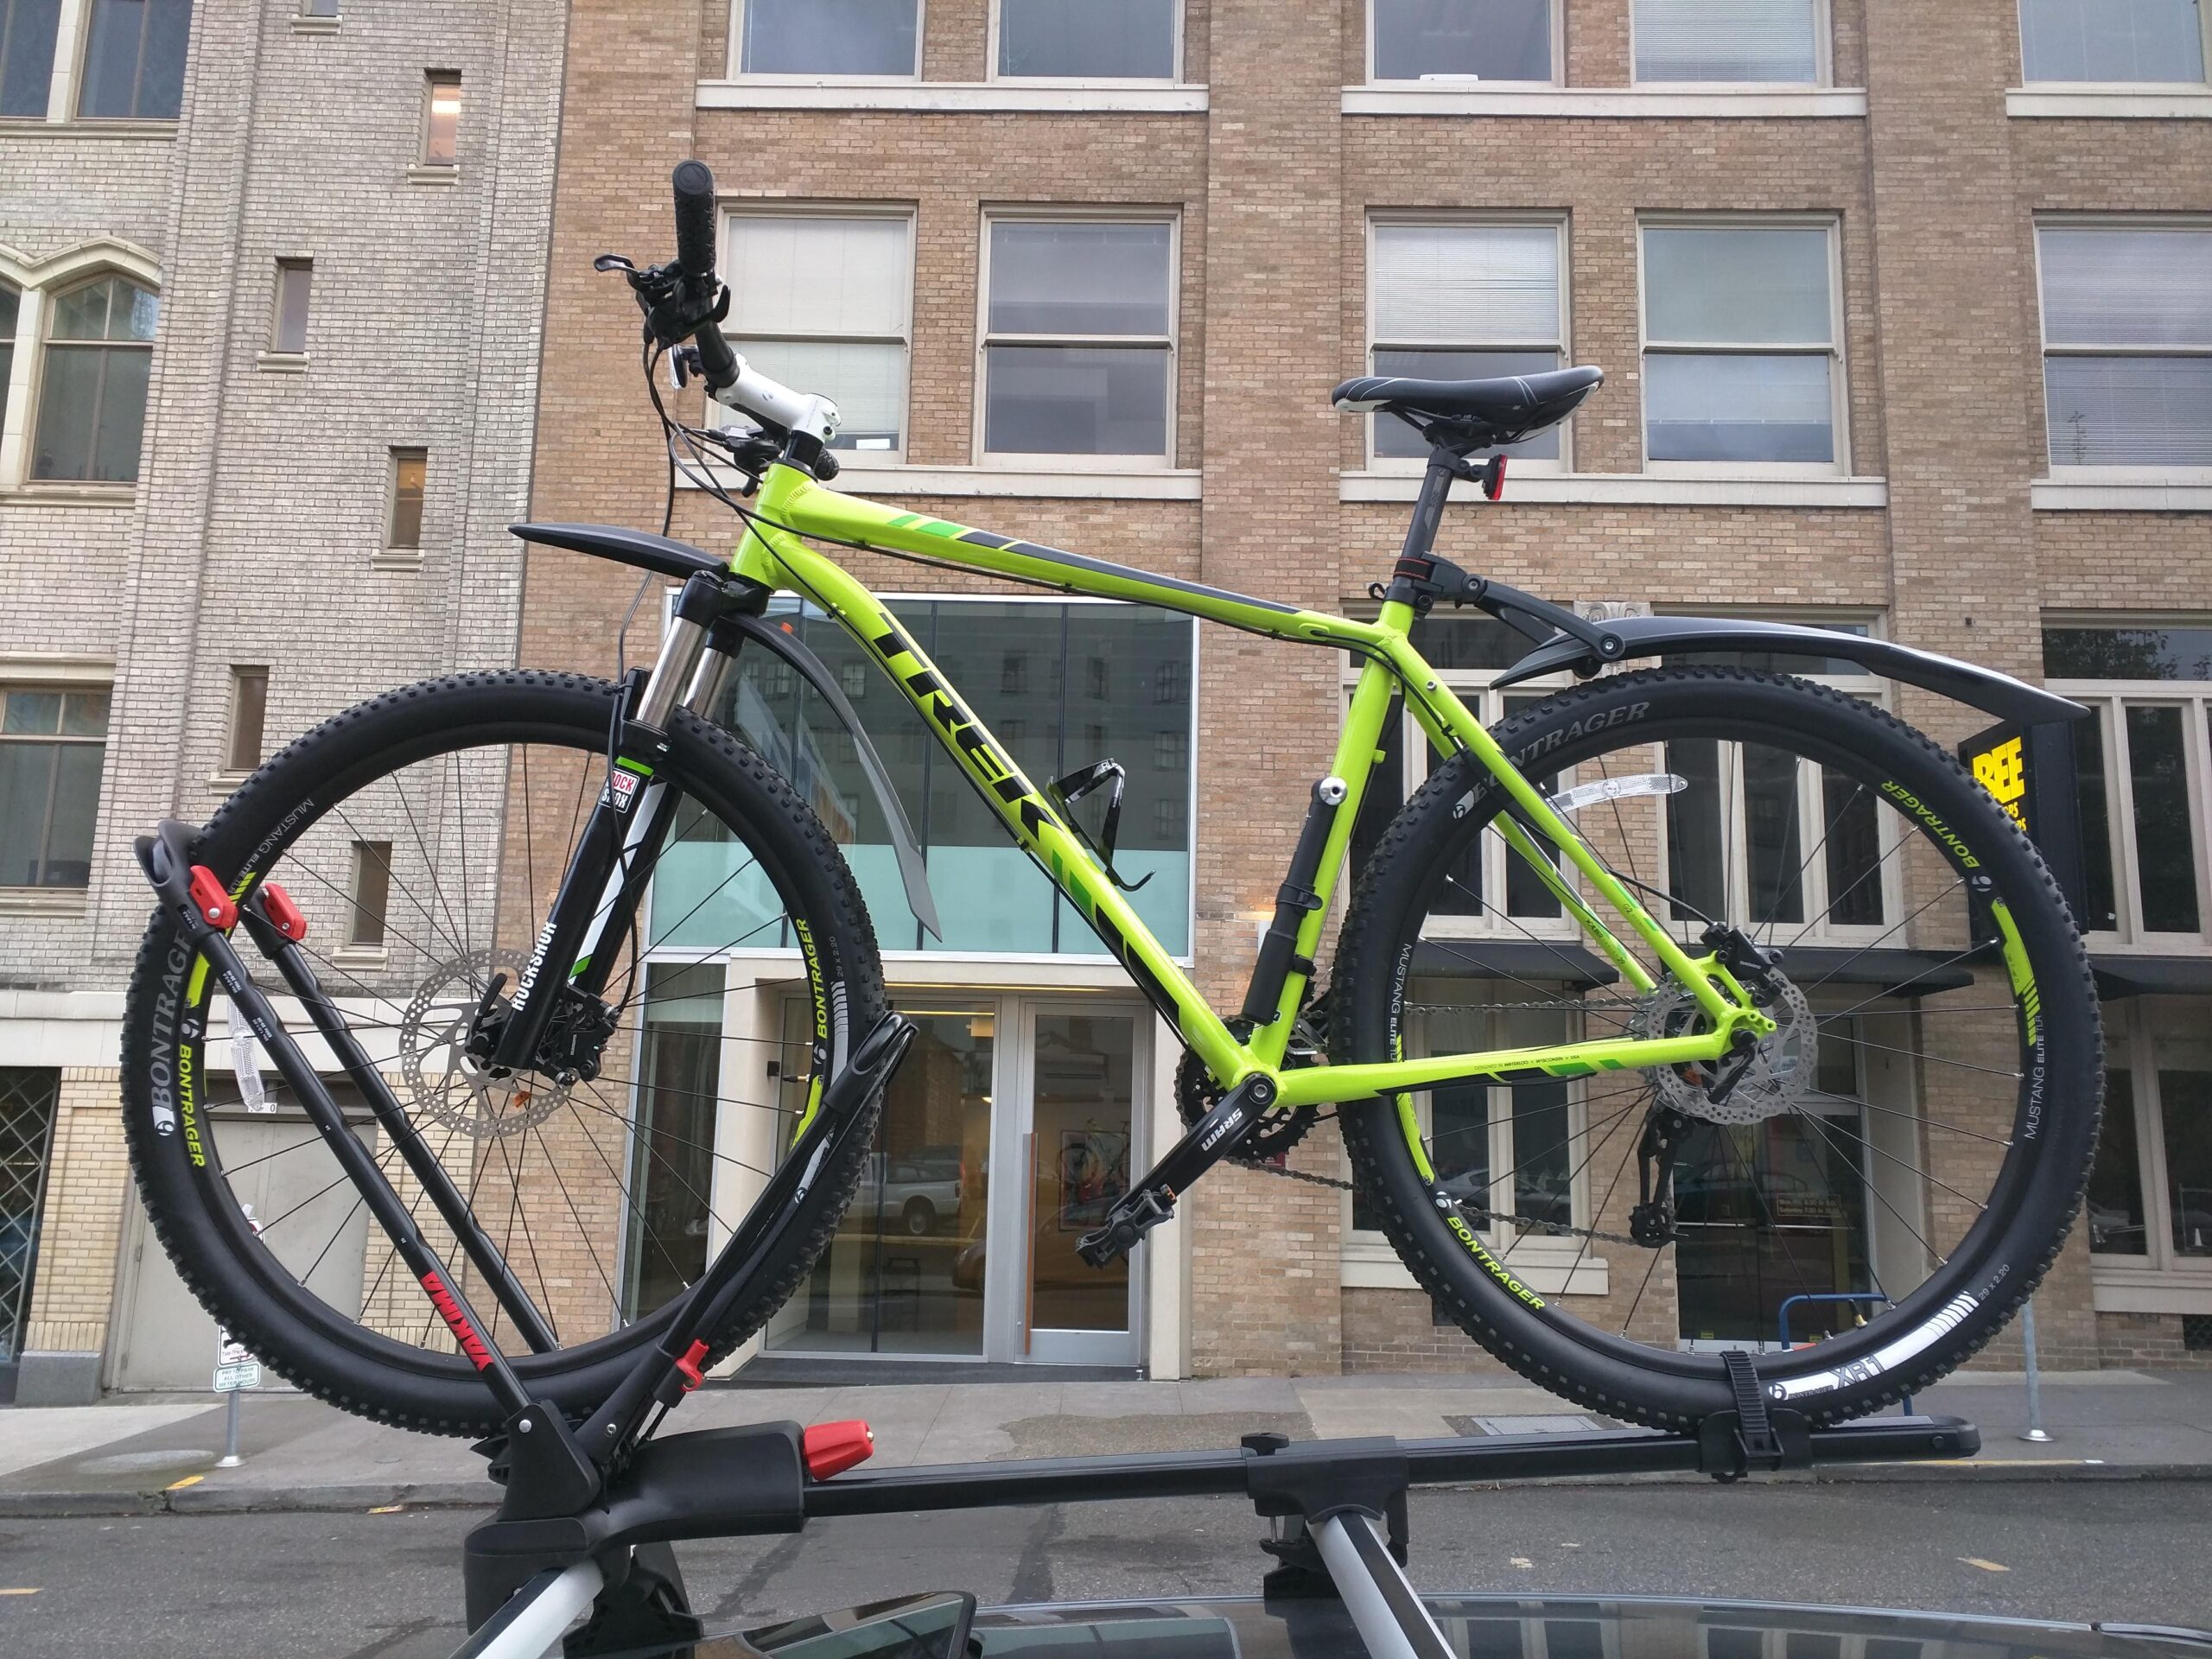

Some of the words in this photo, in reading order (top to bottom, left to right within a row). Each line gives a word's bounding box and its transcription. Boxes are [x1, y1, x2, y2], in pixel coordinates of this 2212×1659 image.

[873, 612, 1065, 842] TREK
[259, 798, 315, 854] MUSTANG
[1881, 779, 1980, 868] BONTRAGER
[241, 853, 259, 878] ELITE
[512, 921, 557, 1011] ROCKSHOX
[796, 918, 828, 1039] BONTRAGER
[836, 965, 844, 977] 29
[1390, 943, 1413, 1014] MUSTANG
[179, 1044, 207, 1167] BONTRAGER
[2024, 1066, 2044, 1140] MUSTANG
[2037, 1034, 2045, 1063] ELITE
[1201, 1107, 1243, 1152] SRAM
[1446, 1217, 1546, 1310] BONTRAGER
[1979, 1288, 1990, 1301] 29
[1993, 1264, 2010, 1284] 2.20
[420, 1270, 494, 1373] YAKIMA
[1789, 1384, 1834, 1400] BONTRAGER
[1830, 1355, 1885, 1389] XR1
